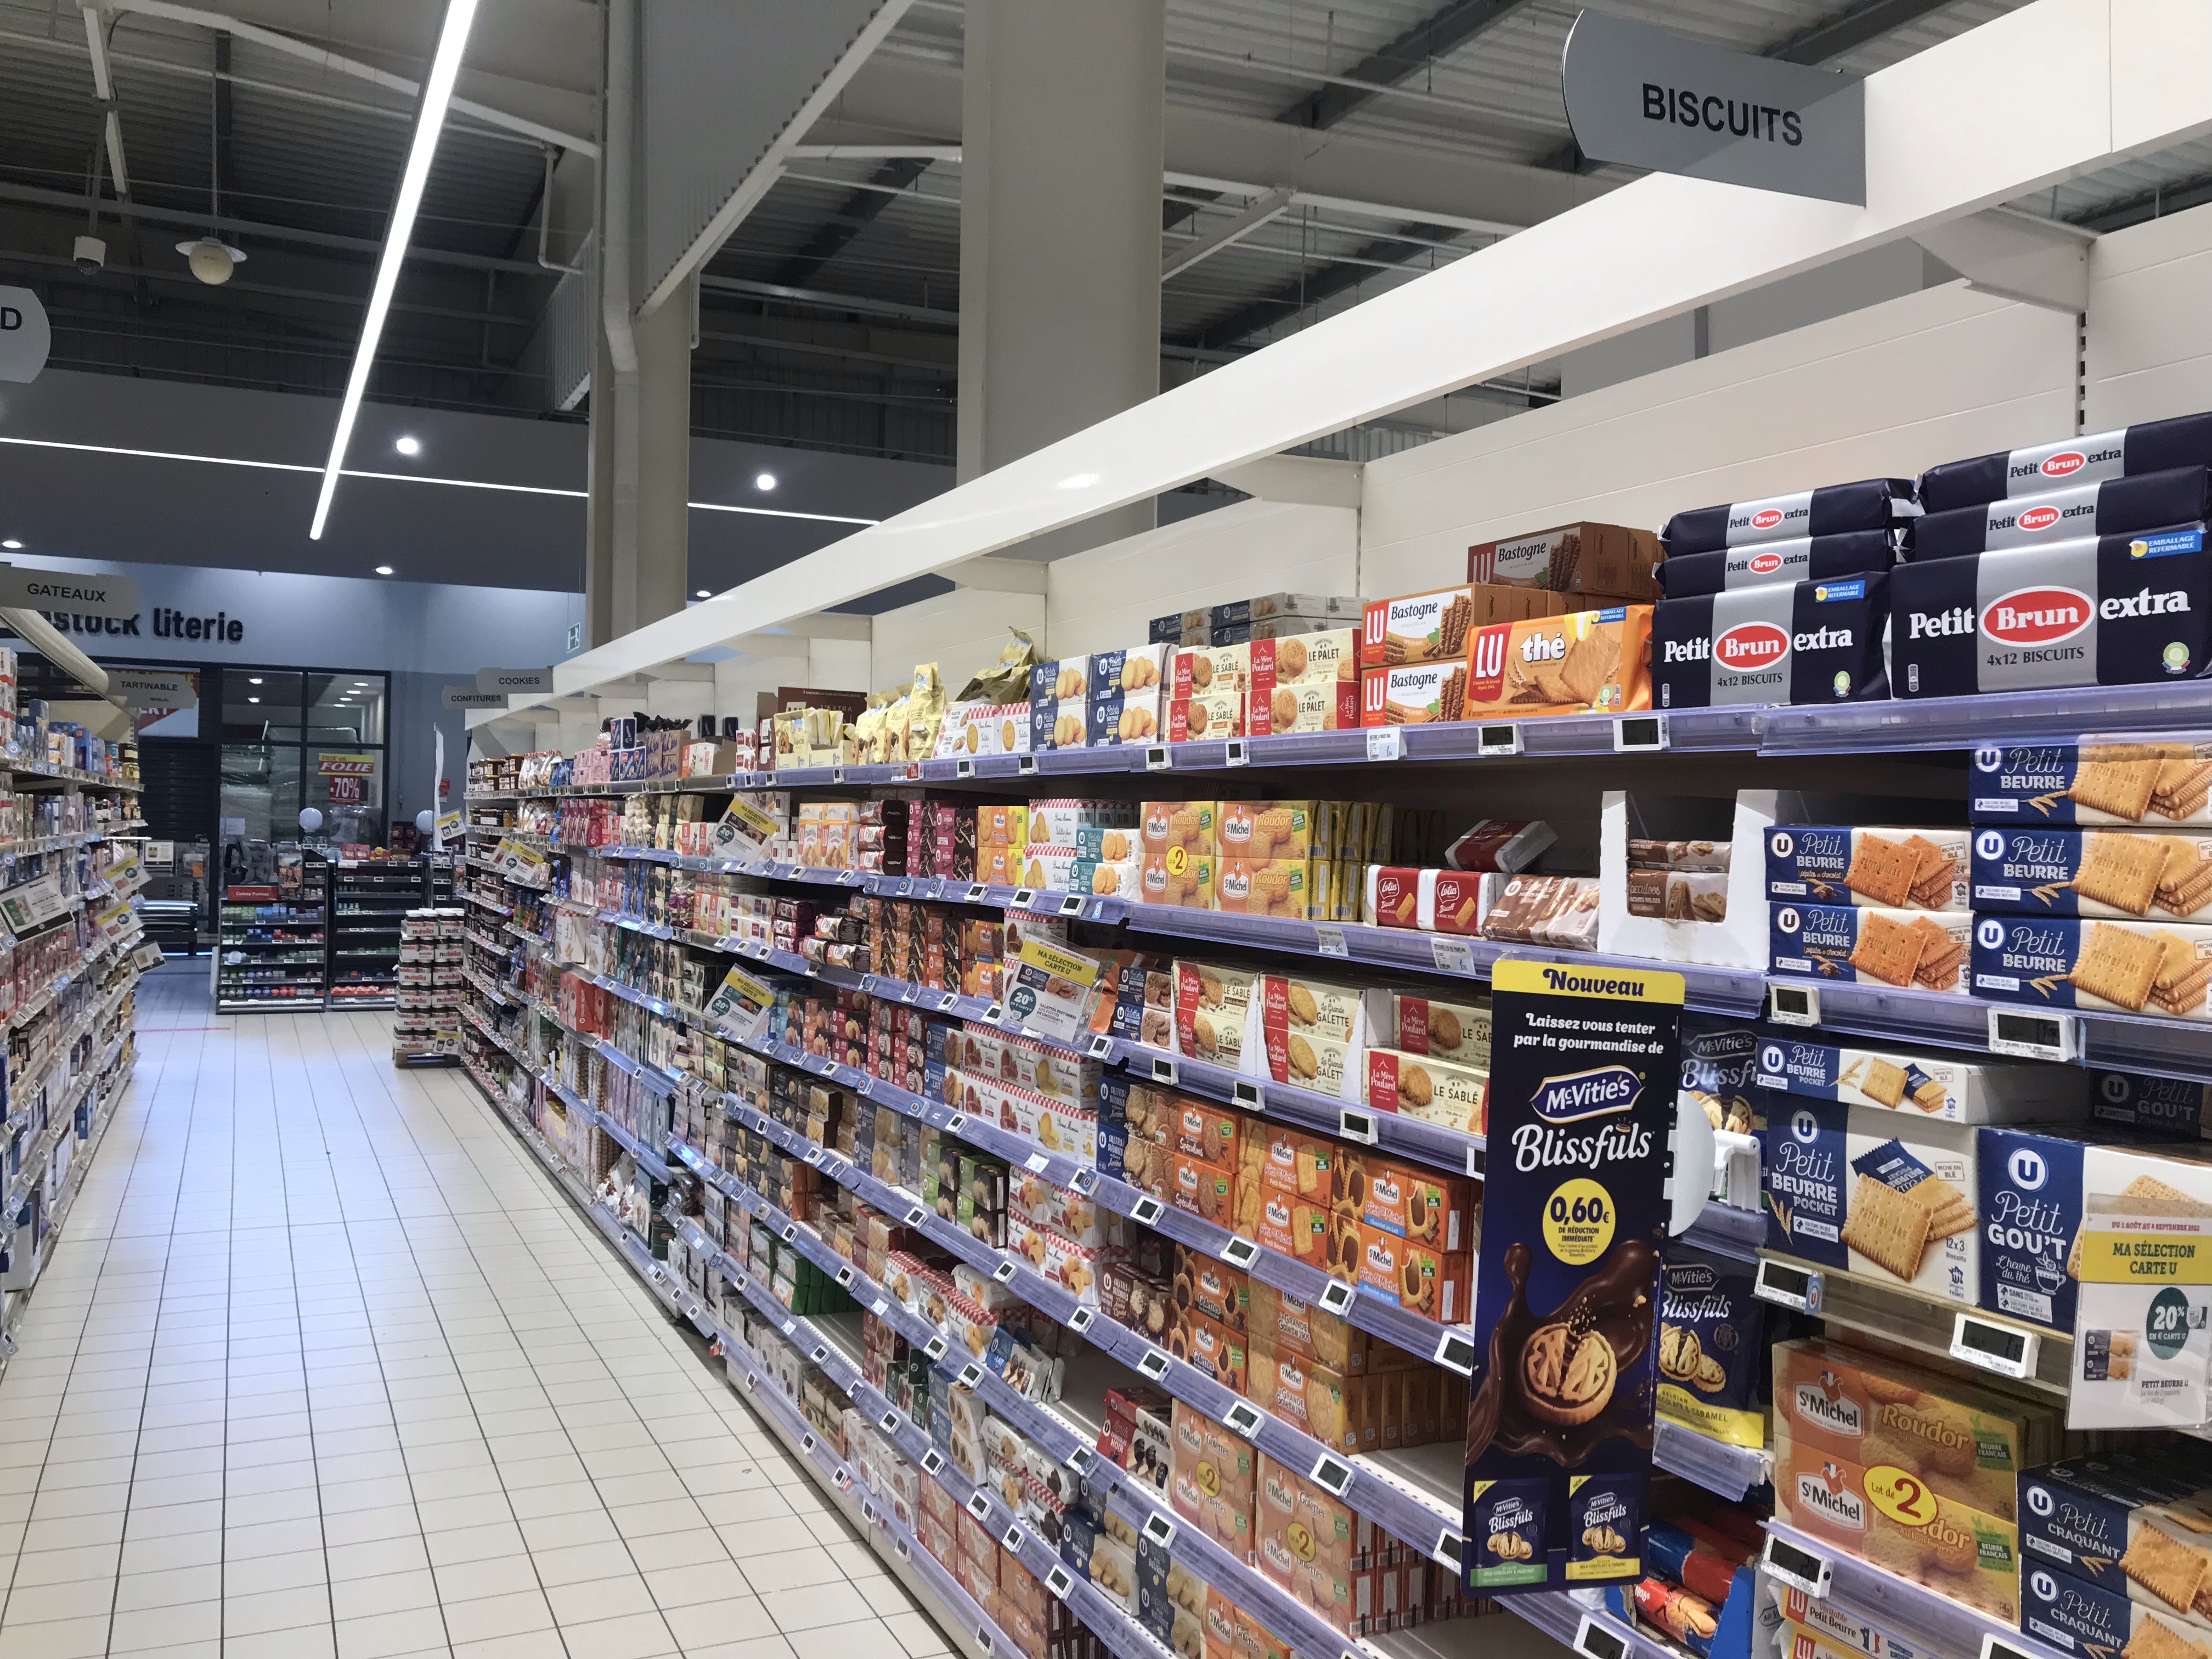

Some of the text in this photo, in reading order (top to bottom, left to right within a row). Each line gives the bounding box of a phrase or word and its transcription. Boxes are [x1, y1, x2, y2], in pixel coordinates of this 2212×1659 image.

[1643, 83, 1803, 146] BISCUITS
[2010, 449, 2121, 478] Petit Brun extra
[1730, 509, 1808, 528] Petit Brun extra
[1989, 505, 2094, 531] Petit Brun extra
[2148, 535, 2195, 546] EMBALLAGE
[2148, 542, 2195, 554] REFERMABLE
[1498, 541, 1546, 562] Bastogne
[1728, 555, 1808, 572] Petit Brun extra
[27, 583, 106, 602] GATEAUX
[1391, 603, 1437, 620] Bastogne
[1909, 588, 2191, 639] Petit Brun extra
[154, 607, 243, 641] literie
[1366, 610, 1384, 645] LU
[1520, 631, 1565, 662] thé
[1664, 625, 1853, 663] Petit Brun extra
[1309, 648, 1339, 662] LE PALET
[1476, 634, 1504, 678] LU
[1987, 647, 2084, 665] 4x12 BISCUITS
[1221, 659, 1238, 672] SABLÉ
[1252, 662, 1273, 672] Poulard
[121, 681, 178, 691] TARTINABLE
[1391, 673, 1437, 689] Bastogne
[1718, 673, 1782, 686] 4x12 BISCUITS
[1366, 677, 1384, 711] LU
[1208, 710, 1233, 720] LE SABLÉ
[1251, 712, 1269, 721] Poulard
[1299, 701, 1324, 713] LE PALET
[320, 763, 373, 771] FOLIE
[2001, 776, 2065, 789] BEURRE
[1174, 814, 1199, 826] Roudor
[1259, 814, 1290, 827] Roudor
[1799, 833, 1843, 855] Petit
[2008, 837, 2067, 864] Petit
[1176, 850, 1183, 869] 2
[1797, 856, 1844, 869] BEURRE
[1256, 870, 1288, 884] Roudor
[2004, 866, 2068, 879] BEURRE
[1382, 881, 1397, 893] Lotus
[1441, 884, 1457, 896] Lotus
[1381, 899, 1396, 909] Biscoff
[1439, 903, 1455, 913] Biscoff
[1803, 932, 1850, 947] BEURRE
[2007, 927, 2065, 956] Petit
[1037, 950, 1047, 958] MA
[1048, 954, 1082, 972] SÉLECTION
[1045, 961, 1064, 973] CARTE
[1223, 985, 1250, 998] LE SABLÉ
[1543, 968, 1644, 997] Nouveau
[1014, 992, 1033, 1005] 20%
[1317, 1013, 1348, 1027] GALETTE
[1402, 1022, 1425, 1035] Poulard
[1526, 1013, 1656, 1035] Laissez vous tenter
[1216, 1034, 1240, 1048] LE SABL
[1514, 1034, 1664, 1054] par la gourmandise de
[1381, 1071, 1395, 1081] Mère
[1787, 1064, 1826, 1079] BEURRE
[1371, 1077, 1395, 1091] Poulard
[1799, 1076, 1825, 1087] POCKET
[1434, 1085, 1478, 1104] LE SABLÉ
[1546, 1077, 1630, 1113] McVitie's
[1180, 1138, 1204, 1157] Spéculoos
[1511, 1122, 1650, 1172] Blissfuls
[1776, 1142, 1834, 1182] Petit
[2018, 1159, 2038, 1182] U
[1772, 1173, 1837, 1203] BEURRE
[1176, 1193, 1199, 1213] Spéculoos
[1793, 1195, 1837, 1216] POCKET
[1991, 1190, 2063, 1235] Petit
[1568, 1226, 1599, 1234] RÉDUCTION
[1988, 1224, 2066, 1260] GOU'T
[2113, 1241, 2195, 1258] MA SÉLECTION
[1672, 1270, 1712, 1284] McVitie's
[2002, 1269, 2030, 1283] du thé
[2130, 1262, 2177, 1274] CARTE U
[1278, 1319, 1310, 1343] Galette 1905
[1284, 1315, 1308, 1331] GRANDE
[1662, 1391, 1688, 1404] BELGIAN
[1810, 1395, 1858, 1427] Michel
[1882, 1404, 1968, 1450] Roudor
[1110, 1439, 1124, 1453] NOIR
[1206, 1434, 1229, 1457] Galettes
[1272, 1486, 1292, 1509] Michel
[1300, 1492, 1325, 1519] Galettes
[1813, 1487, 1860, 1521] Michel
[1871, 1478, 1921, 1518] Lot de 2
[1488, 1510, 1533, 1533] Blissfuls
[1584, 1504, 1627, 1527] Blissfuls
[2049, 1523, 2120, 1559] CRAQUANT
[1980, 1549, 2007, 1560] FRANÇAIS
[1810, 1606, 1856, 1638] Petit Beurre
[2051, 1608, 2123, 1648] CRAQUANT
[1236, 1626, 1260, 1653] Galettes
